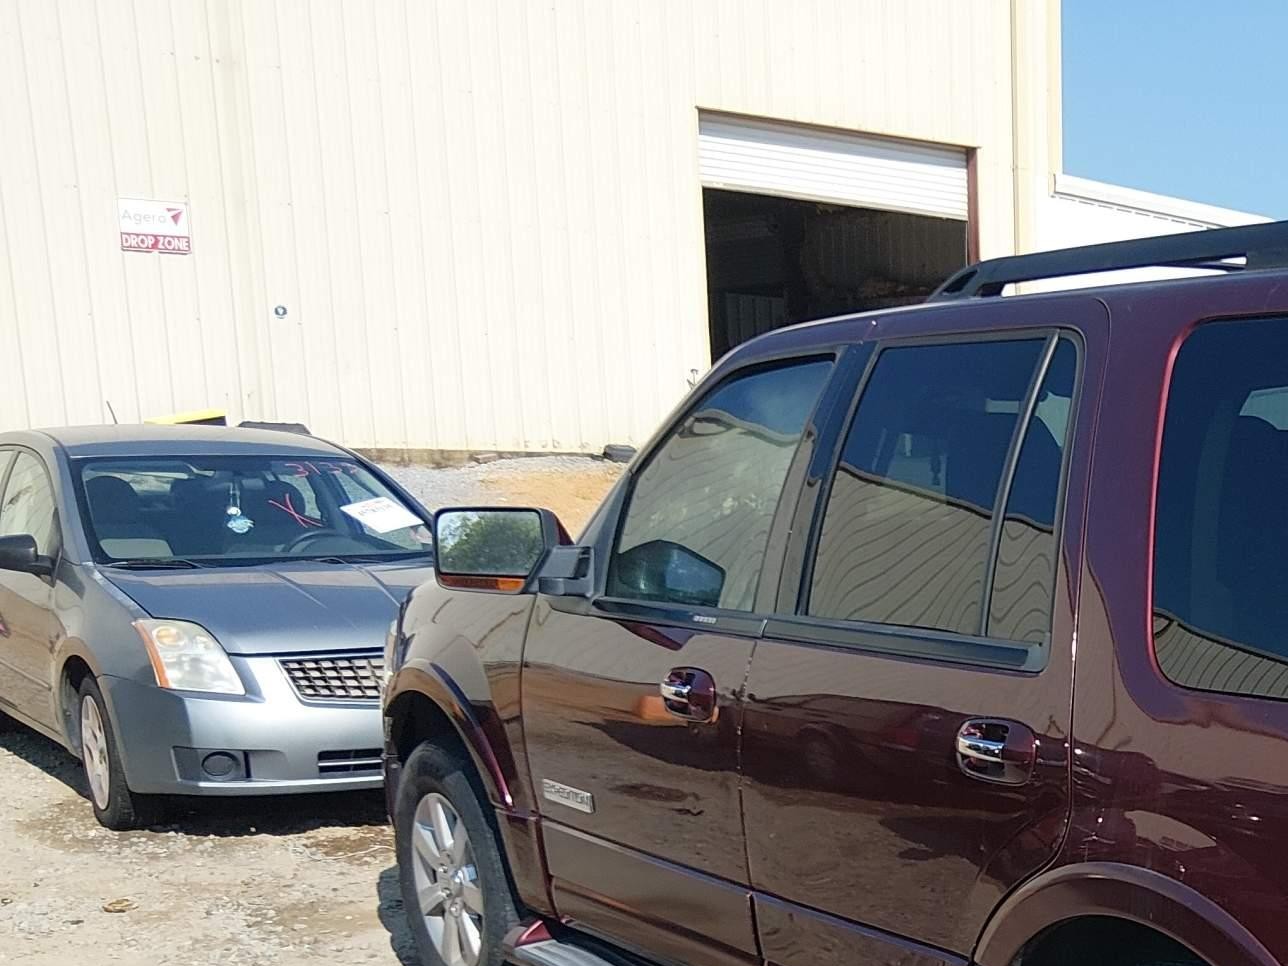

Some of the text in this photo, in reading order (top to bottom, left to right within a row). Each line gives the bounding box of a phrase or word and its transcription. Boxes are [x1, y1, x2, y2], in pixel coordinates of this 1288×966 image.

[121, 209, 167, 225] Agero
[122, 234, 189, 251] DROP ZONE
